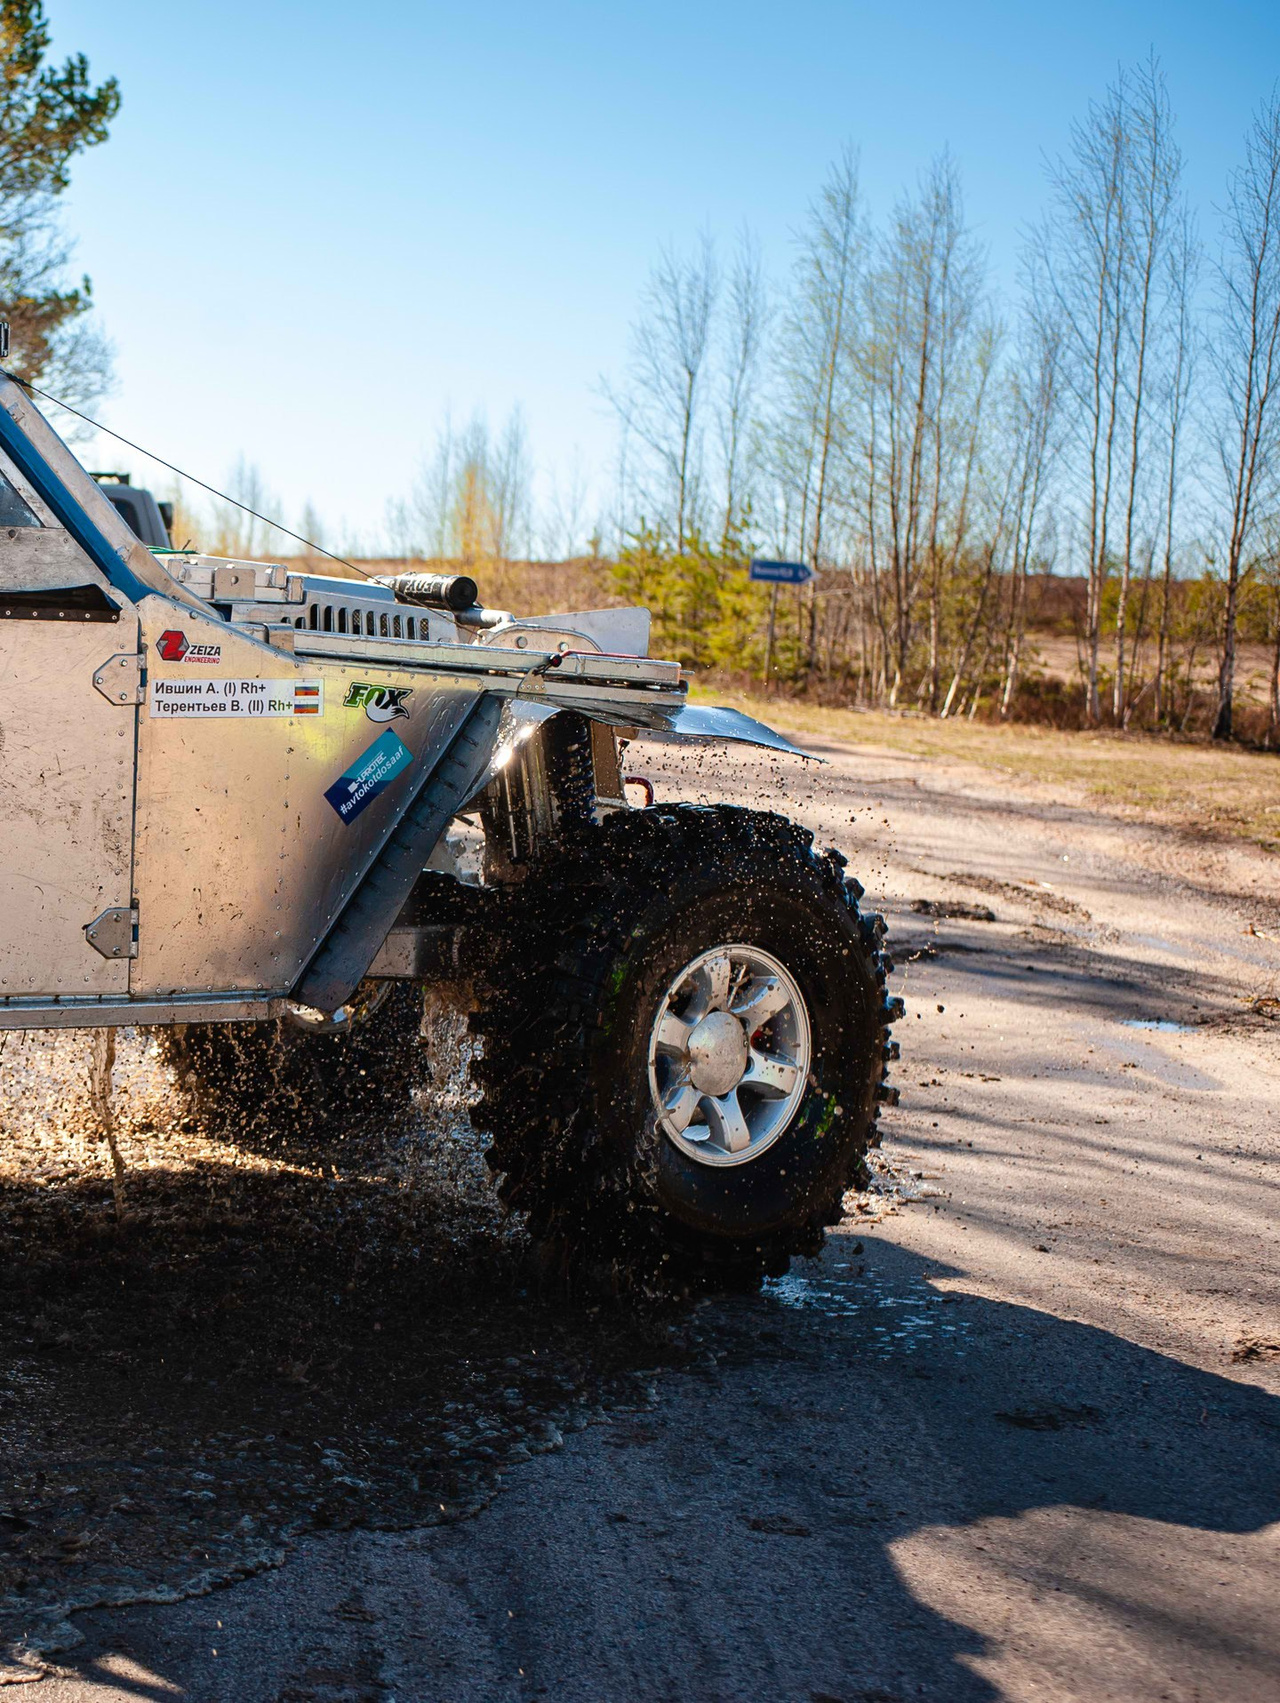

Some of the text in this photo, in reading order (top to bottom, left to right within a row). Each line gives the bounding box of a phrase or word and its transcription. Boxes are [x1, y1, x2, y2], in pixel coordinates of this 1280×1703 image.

[189, 645, 221, 656] ZEIZA
[184, 656, 221, 665] ENGINEERING
[155, 682, 202, 694] Ившин
[240, 682, 266, 694] Rh+
[155, 700, 227, 714] Терентьев
[268, 700, 293, 712] Rh+
[343, 682, 413, 719] FOX
[340, 745, 404, 815] #avtokotdosaaf
